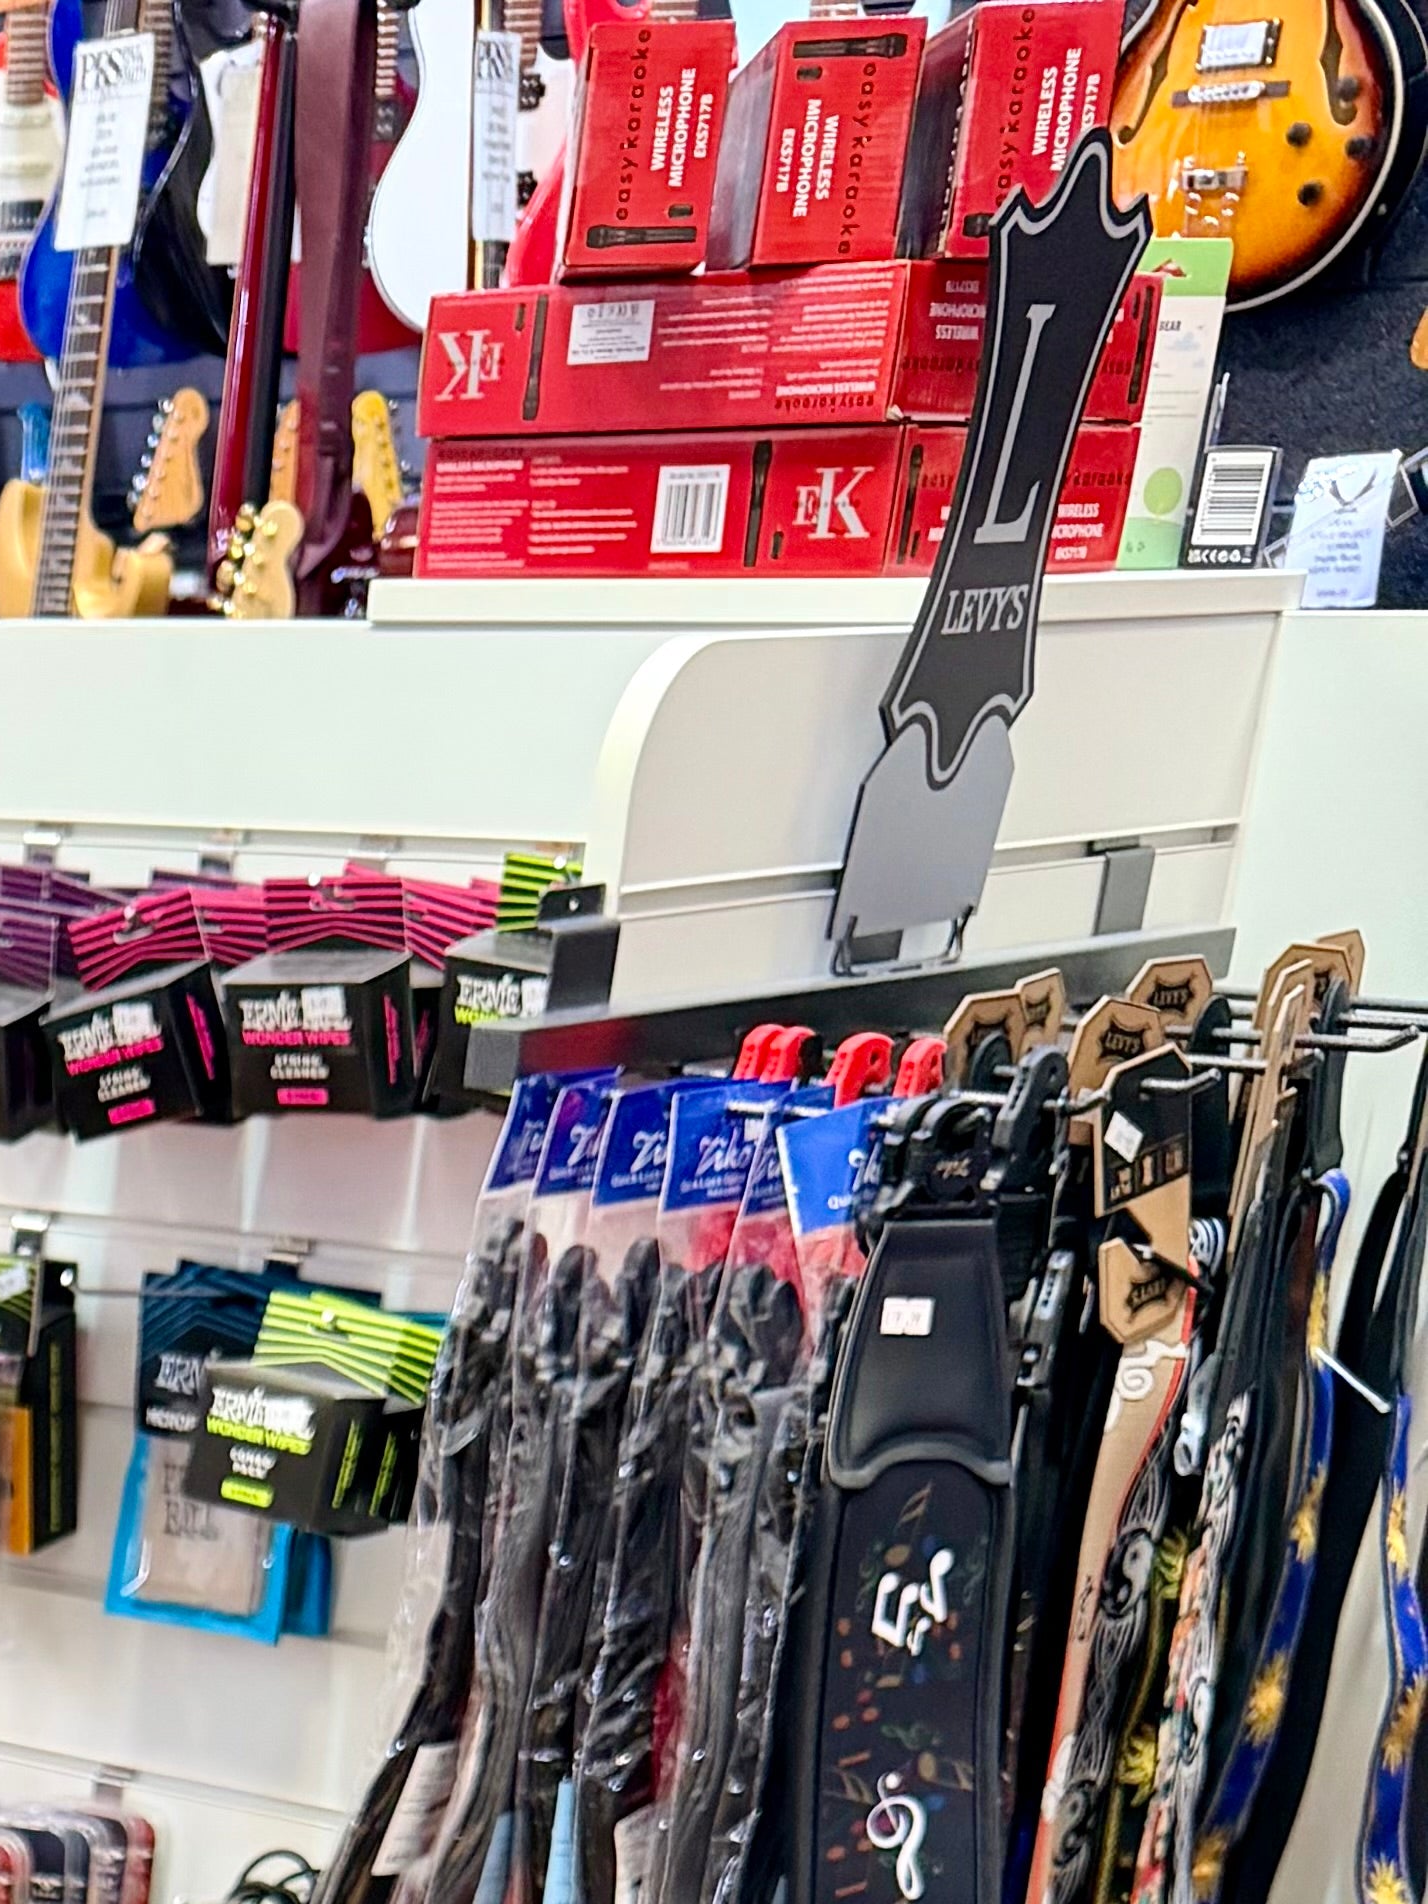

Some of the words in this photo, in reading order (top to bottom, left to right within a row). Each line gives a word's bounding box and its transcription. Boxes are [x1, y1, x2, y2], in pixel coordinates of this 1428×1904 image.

[650, 85, 674, 171] WIRELESS
[668, 68, 697, 187] MICROPHONE
[793, 99, 823, 218] MICROPHONE
[815, 114, 840, 200] WIRELESS
[1032, 66, 1058, 156] WIRELESS
[1049, 47, 1082, 172] MICROPHONE
[973, 304, 1056, 544] L
[243, 1031, 303, 1045] WONDER
